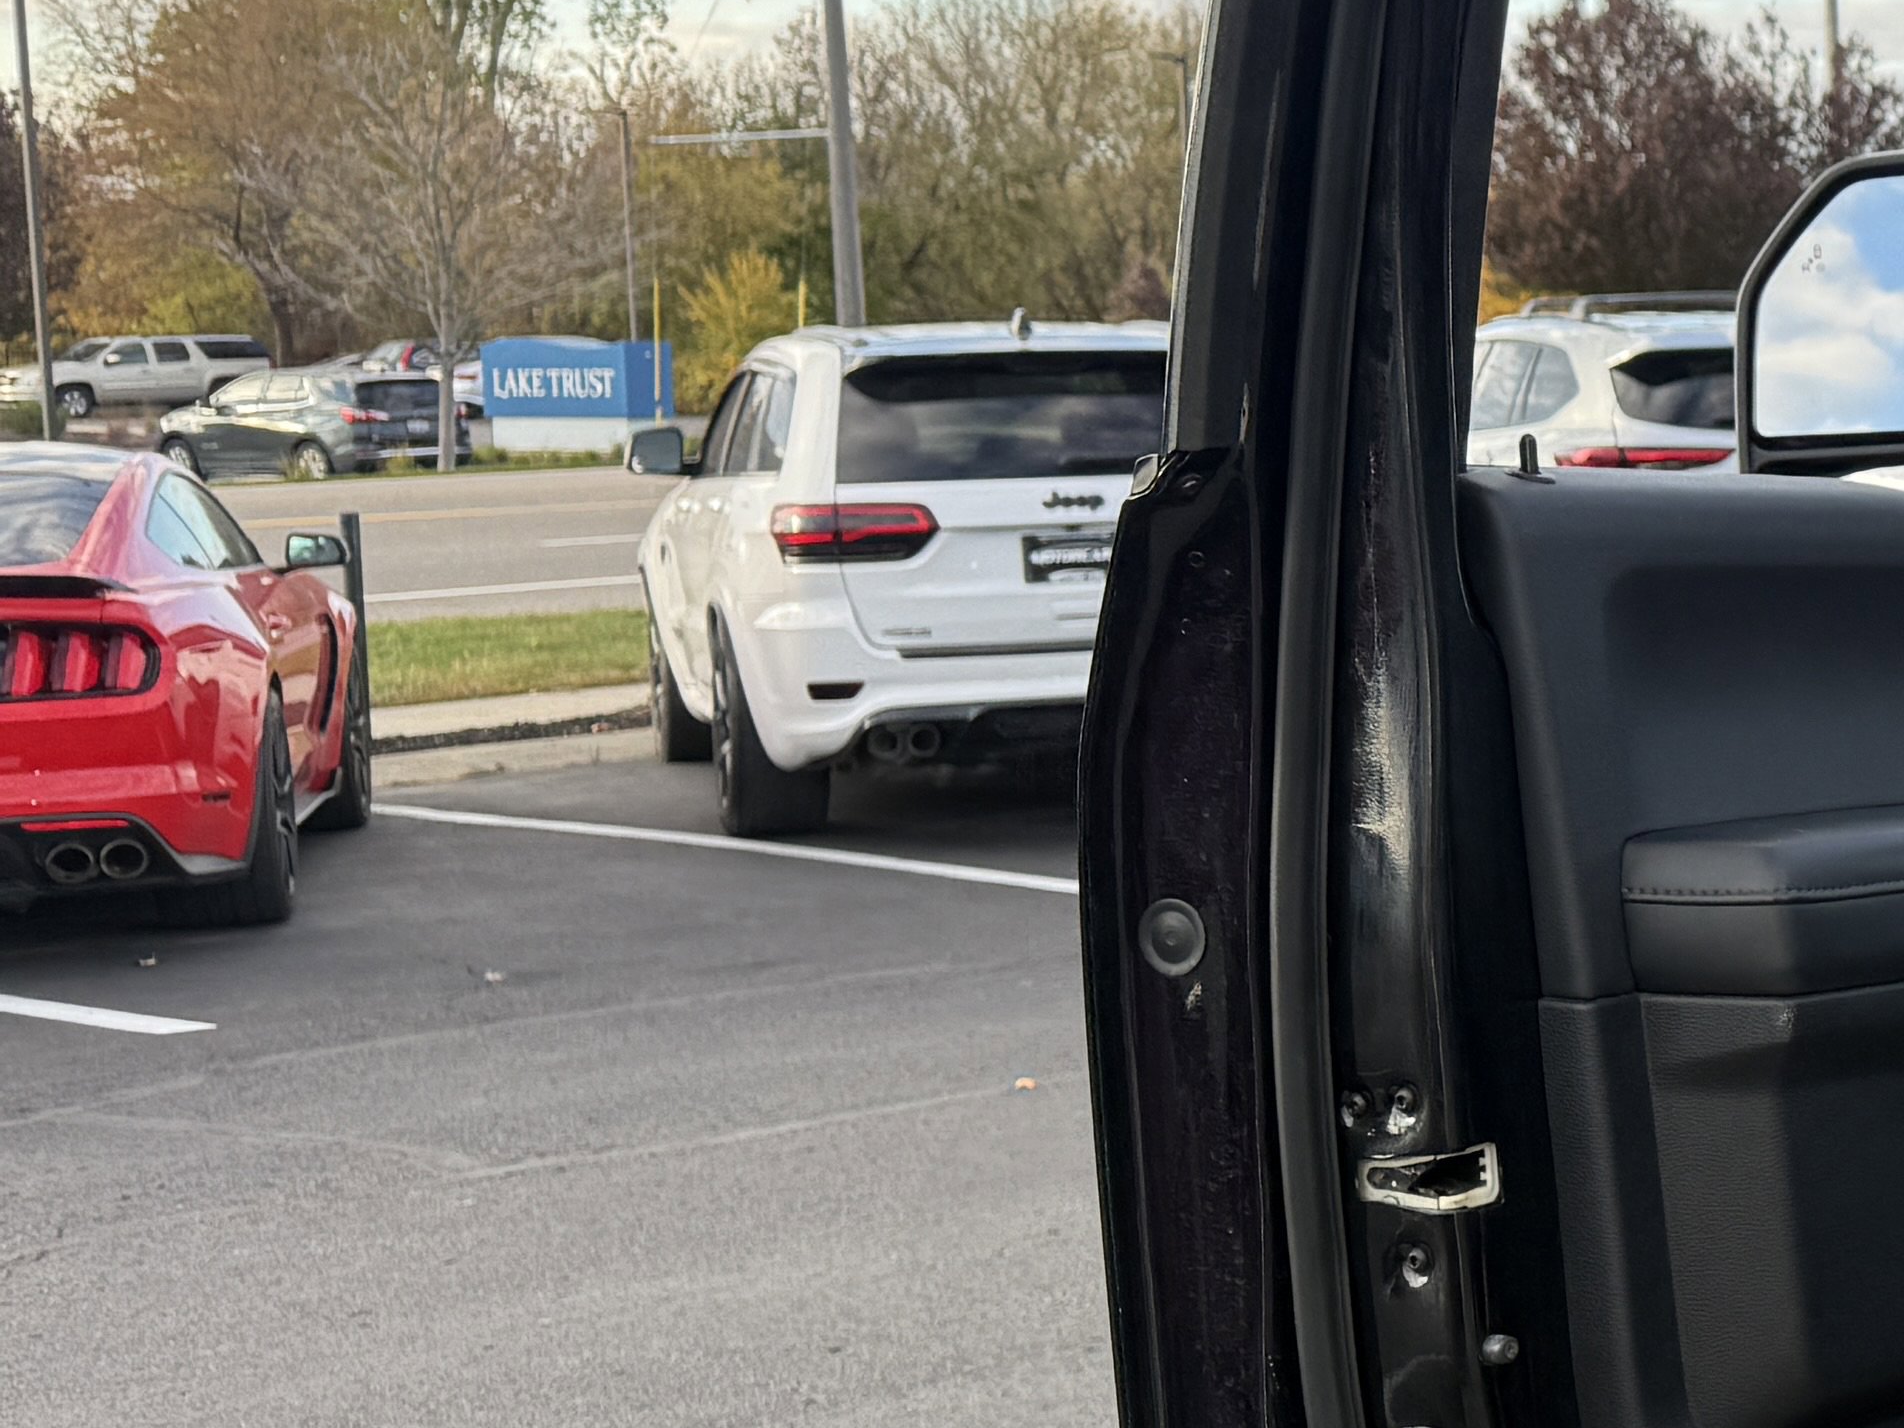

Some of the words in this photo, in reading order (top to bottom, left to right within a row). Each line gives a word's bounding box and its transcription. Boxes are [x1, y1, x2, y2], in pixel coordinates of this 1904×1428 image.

[492, 367, 546, 400] LAKE
[547, 367, 616, 400] TRUST
[1042, 490, 1105, 511] Jeep
